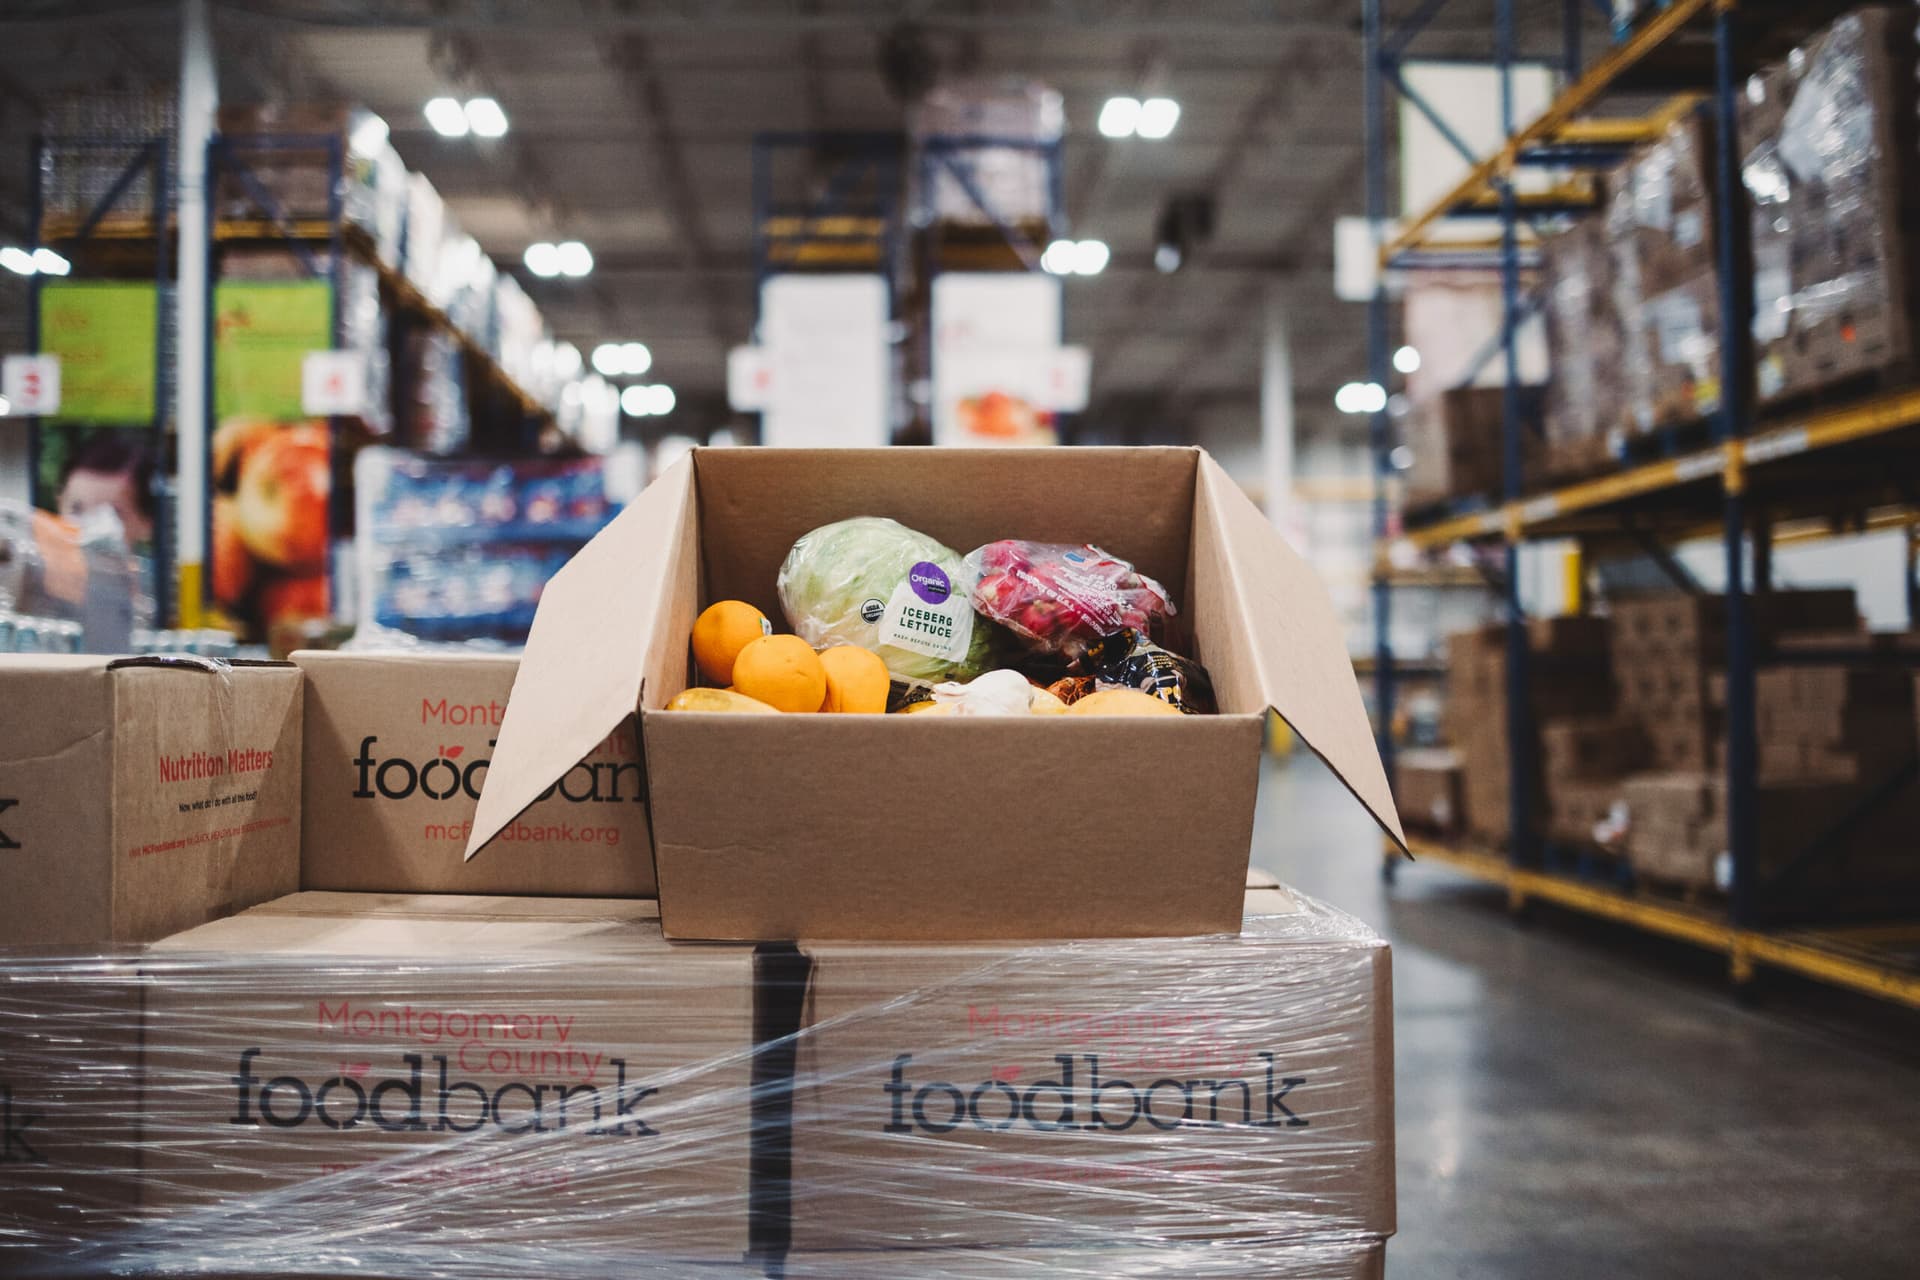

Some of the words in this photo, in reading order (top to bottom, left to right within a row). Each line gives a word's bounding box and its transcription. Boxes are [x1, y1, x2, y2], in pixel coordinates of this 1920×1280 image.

[912, 574, 945, 591] Organic
[899, 617, 953, 638] LETTUCE
[902, 606, 953, 627] ICEBERG
[160, 751, 223, 784] Nutrition
[227, 748, 273, 774] Matters
[425, 819, 620, 846] mcfdbank.org
[317, 1000, 575, 1044] Montgomery
[967, 1003, 1223, 1045] Montgomery
[459, 1040, 602, 1082] County
[1110, 1041, 1252, 1078] County
[229, 1047, 660, 1137] foodbank
[883, 1052, 1310, 1133] foodbank
